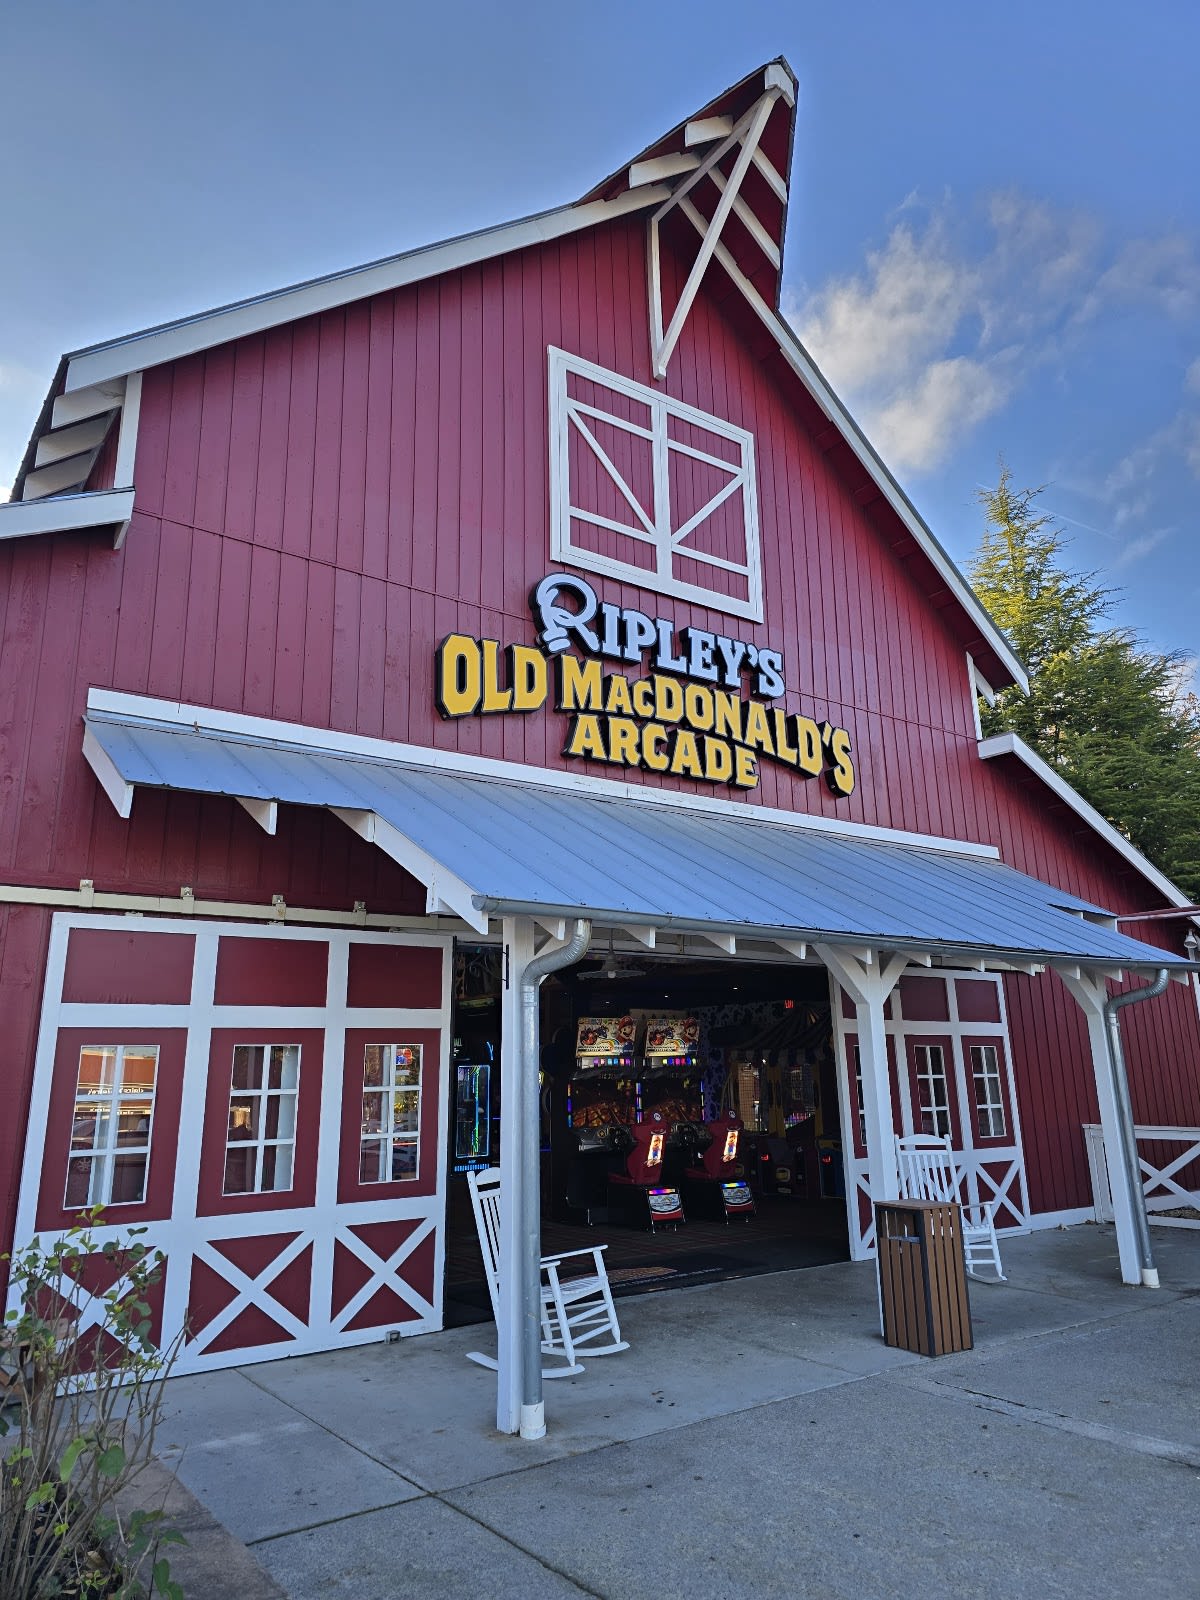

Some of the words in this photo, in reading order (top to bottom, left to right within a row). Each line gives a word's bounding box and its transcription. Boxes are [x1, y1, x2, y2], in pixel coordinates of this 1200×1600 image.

[440, 633, 549, 716] OLD
[534, 572, 784, 698] RIPLEY'S
[569, 714, 760, 789] ARCADE
